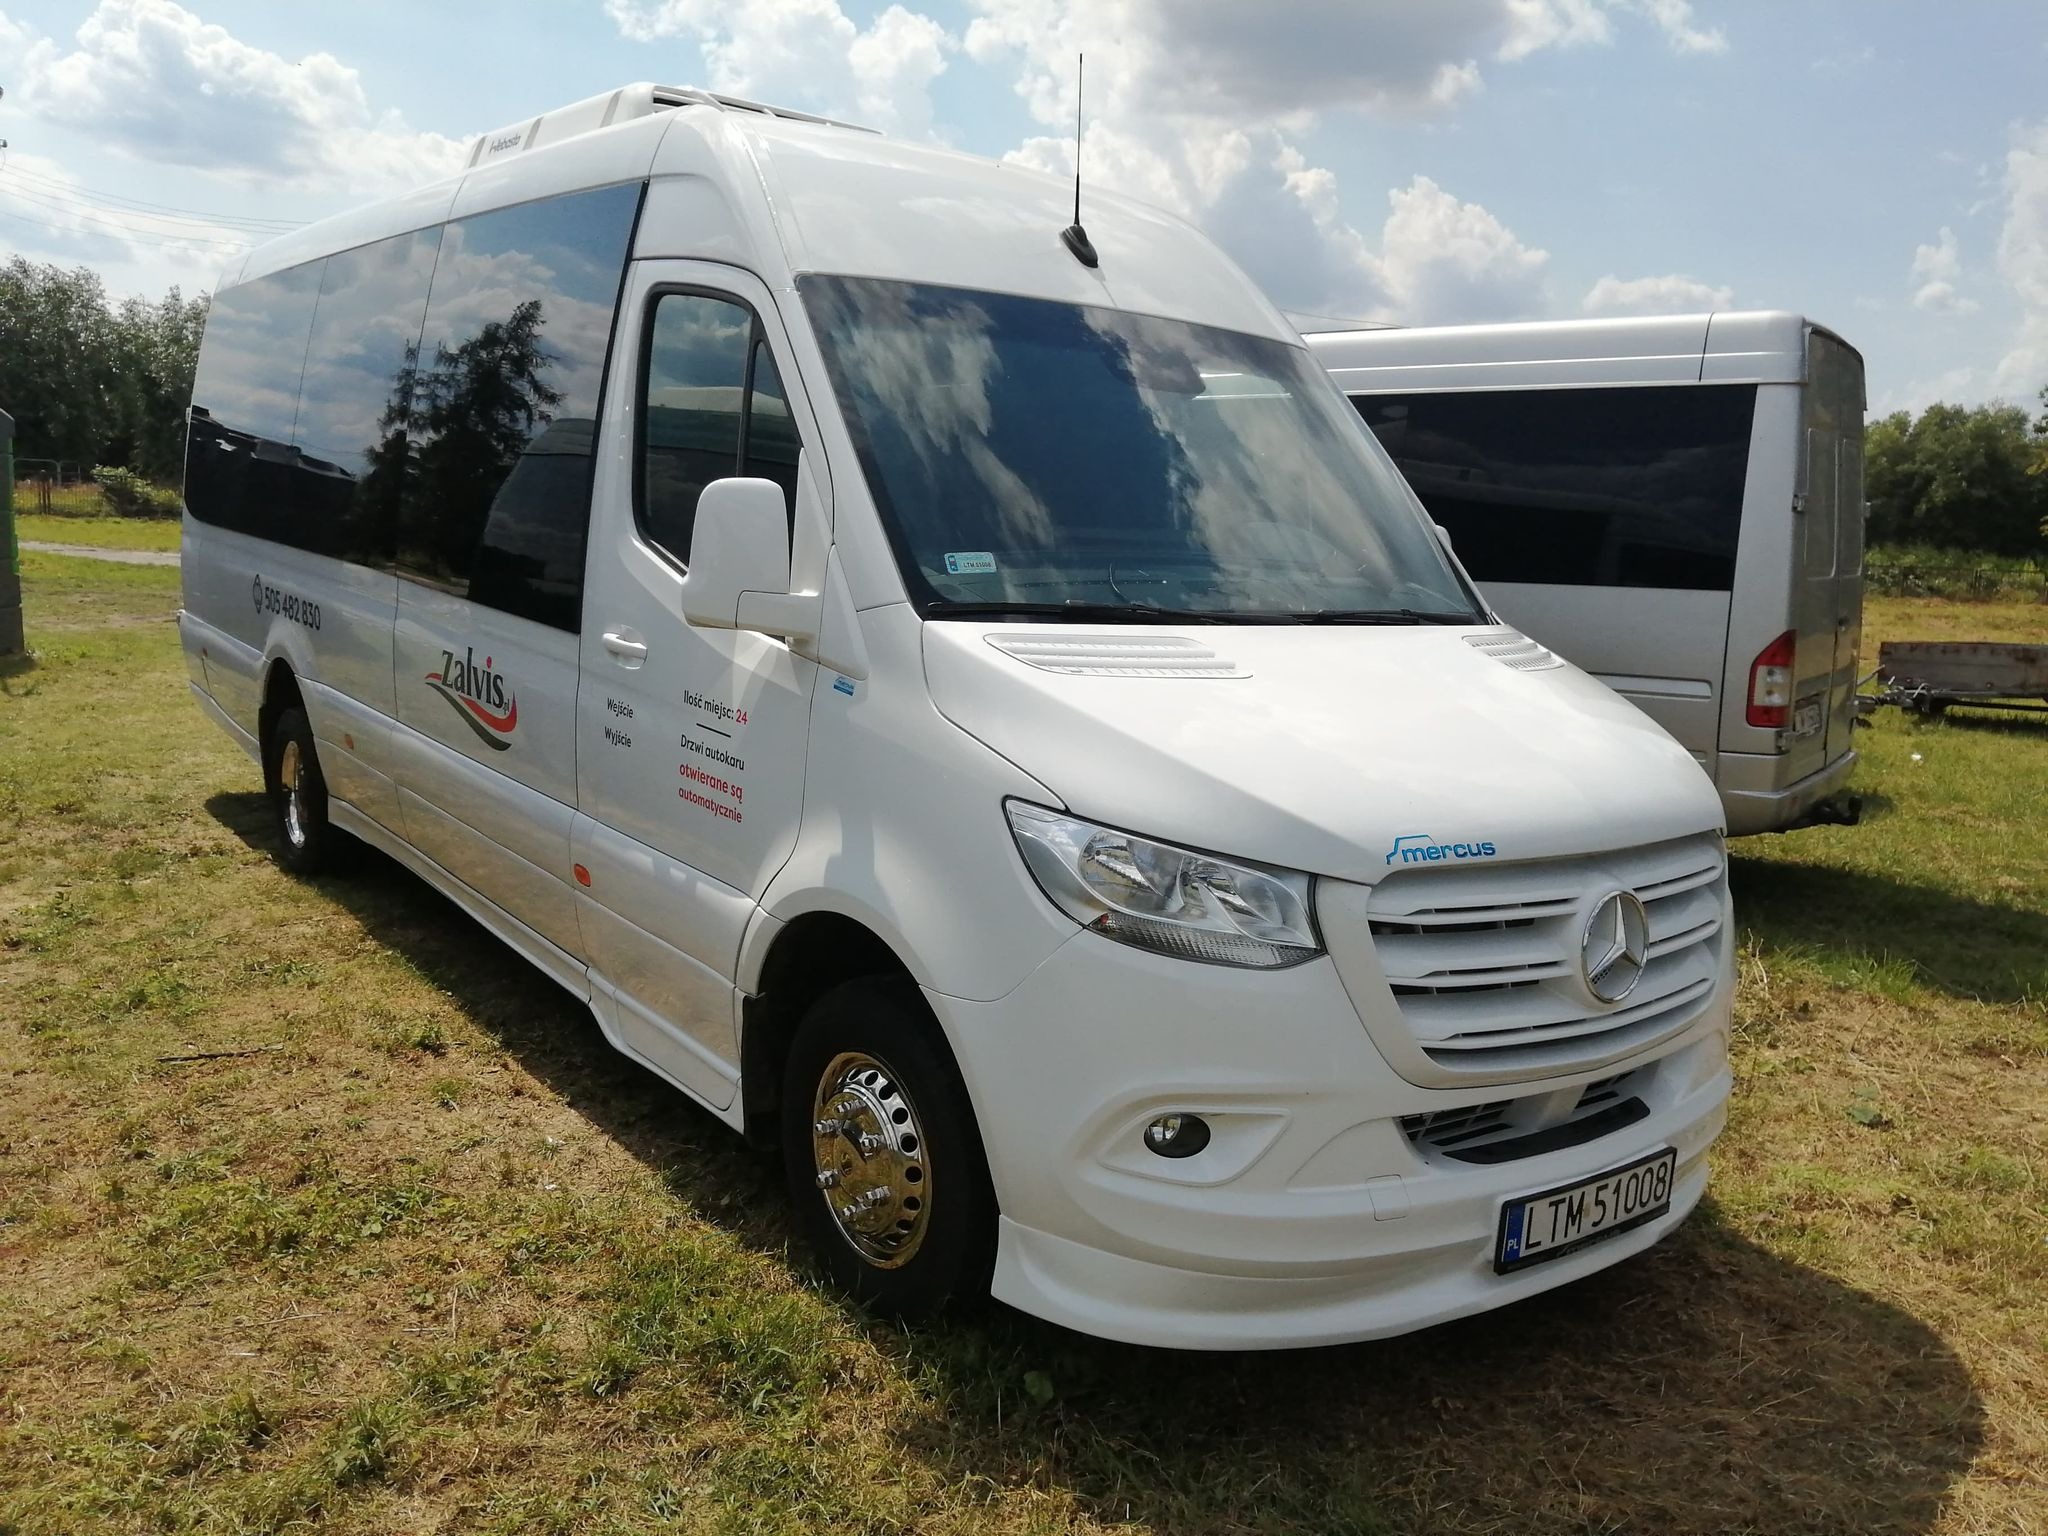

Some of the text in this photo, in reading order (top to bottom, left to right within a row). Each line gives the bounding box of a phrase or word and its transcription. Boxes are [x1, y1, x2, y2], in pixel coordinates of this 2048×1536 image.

[265, 586, 321, 631] 505 482 830
[607, 697, 634, 719] Wejście
[684, 690, 748, 725] Ilość miejsc: 24
[604, 726, 632, 748] Wyjście
[680, 734, 745, 771] Drzwi autokaru
[679, 763, 743, 804] otwierane są
[678, 786, 742, 823] automatycznie
[1401, 842, 1496, 863] mercus
[1507, 1239, 1519, 1251] PL
[1524, 1191, 1586, 1250] LTM
[1591, 1162, 1668, 1228] 51008
